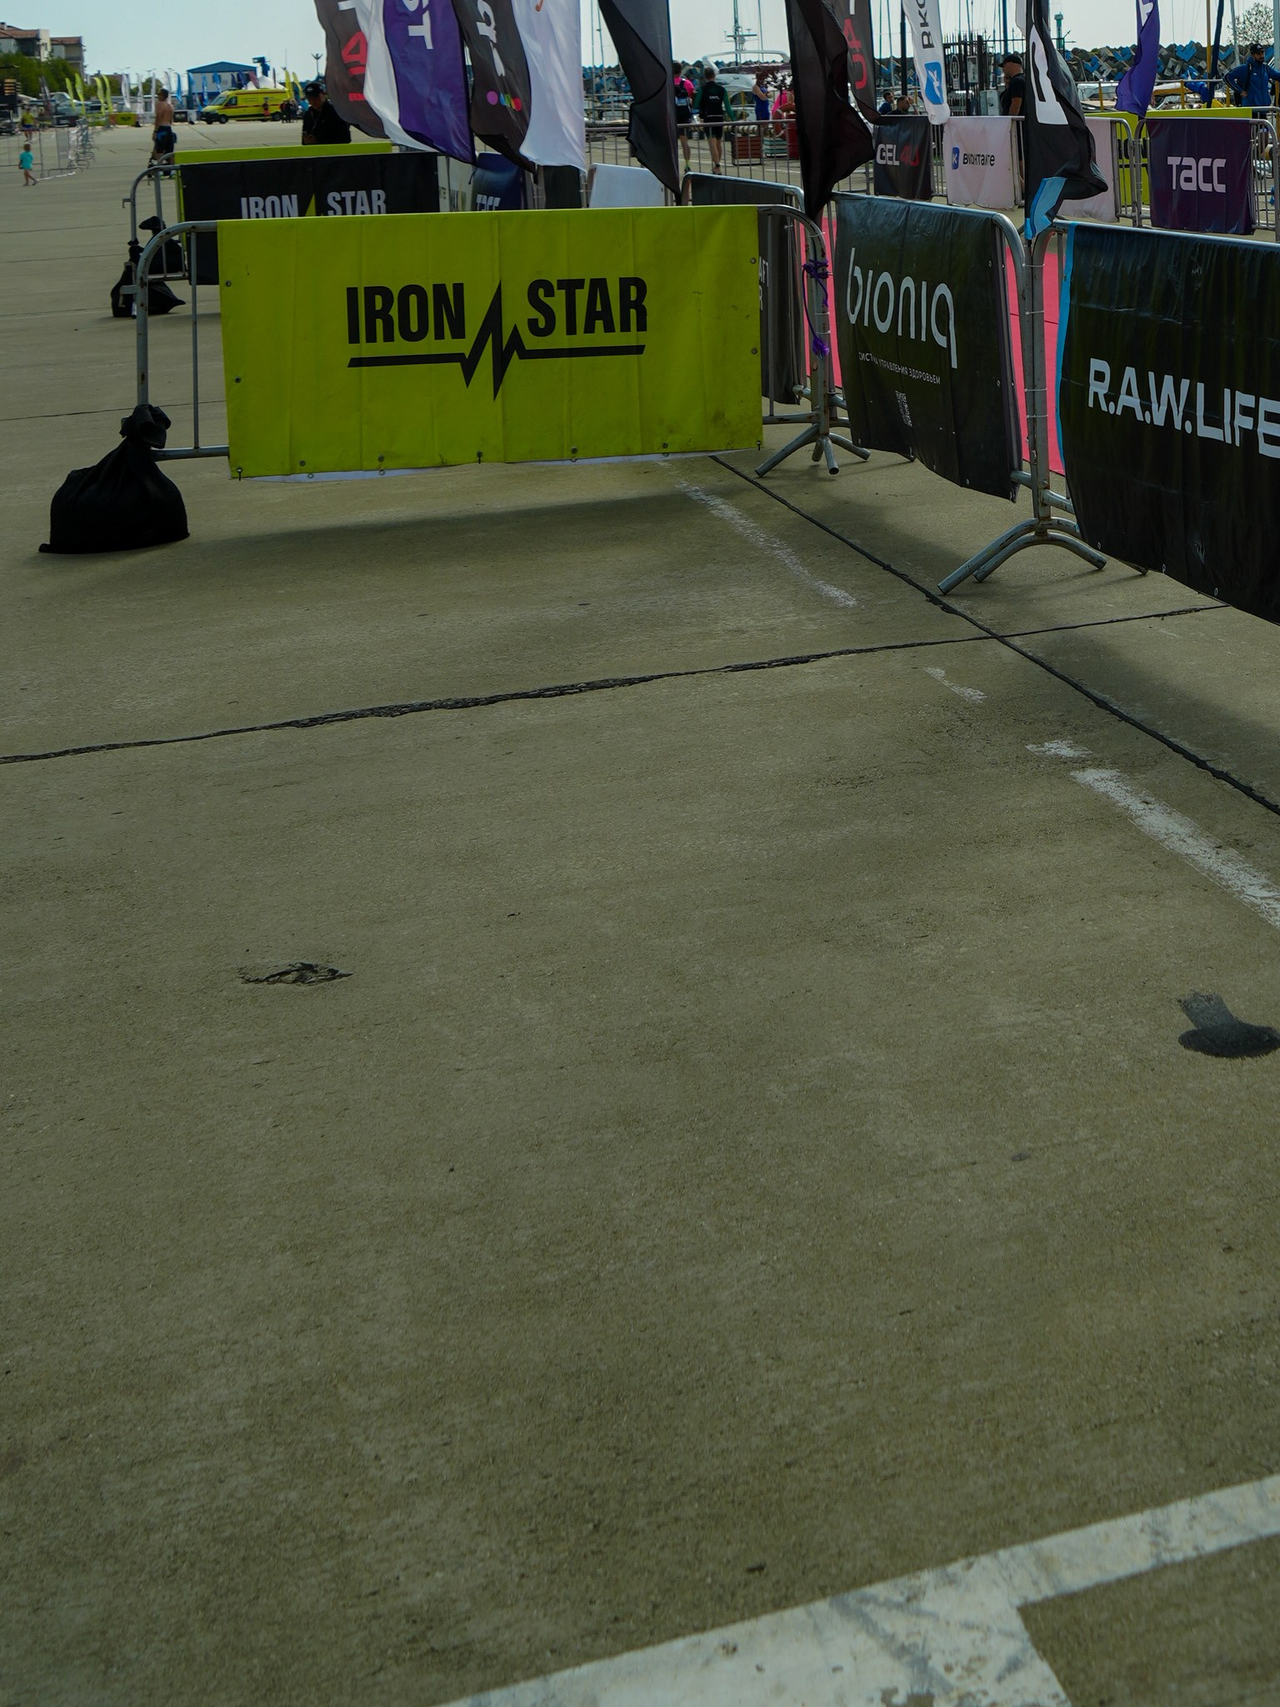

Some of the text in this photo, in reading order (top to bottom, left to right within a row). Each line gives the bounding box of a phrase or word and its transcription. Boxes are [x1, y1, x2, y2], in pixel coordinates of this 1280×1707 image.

[240, 189, 387, 219] IRON STAR
[346, 276, 648, 345] IRON STAR
[846, 247, 958, 370] bioniq
